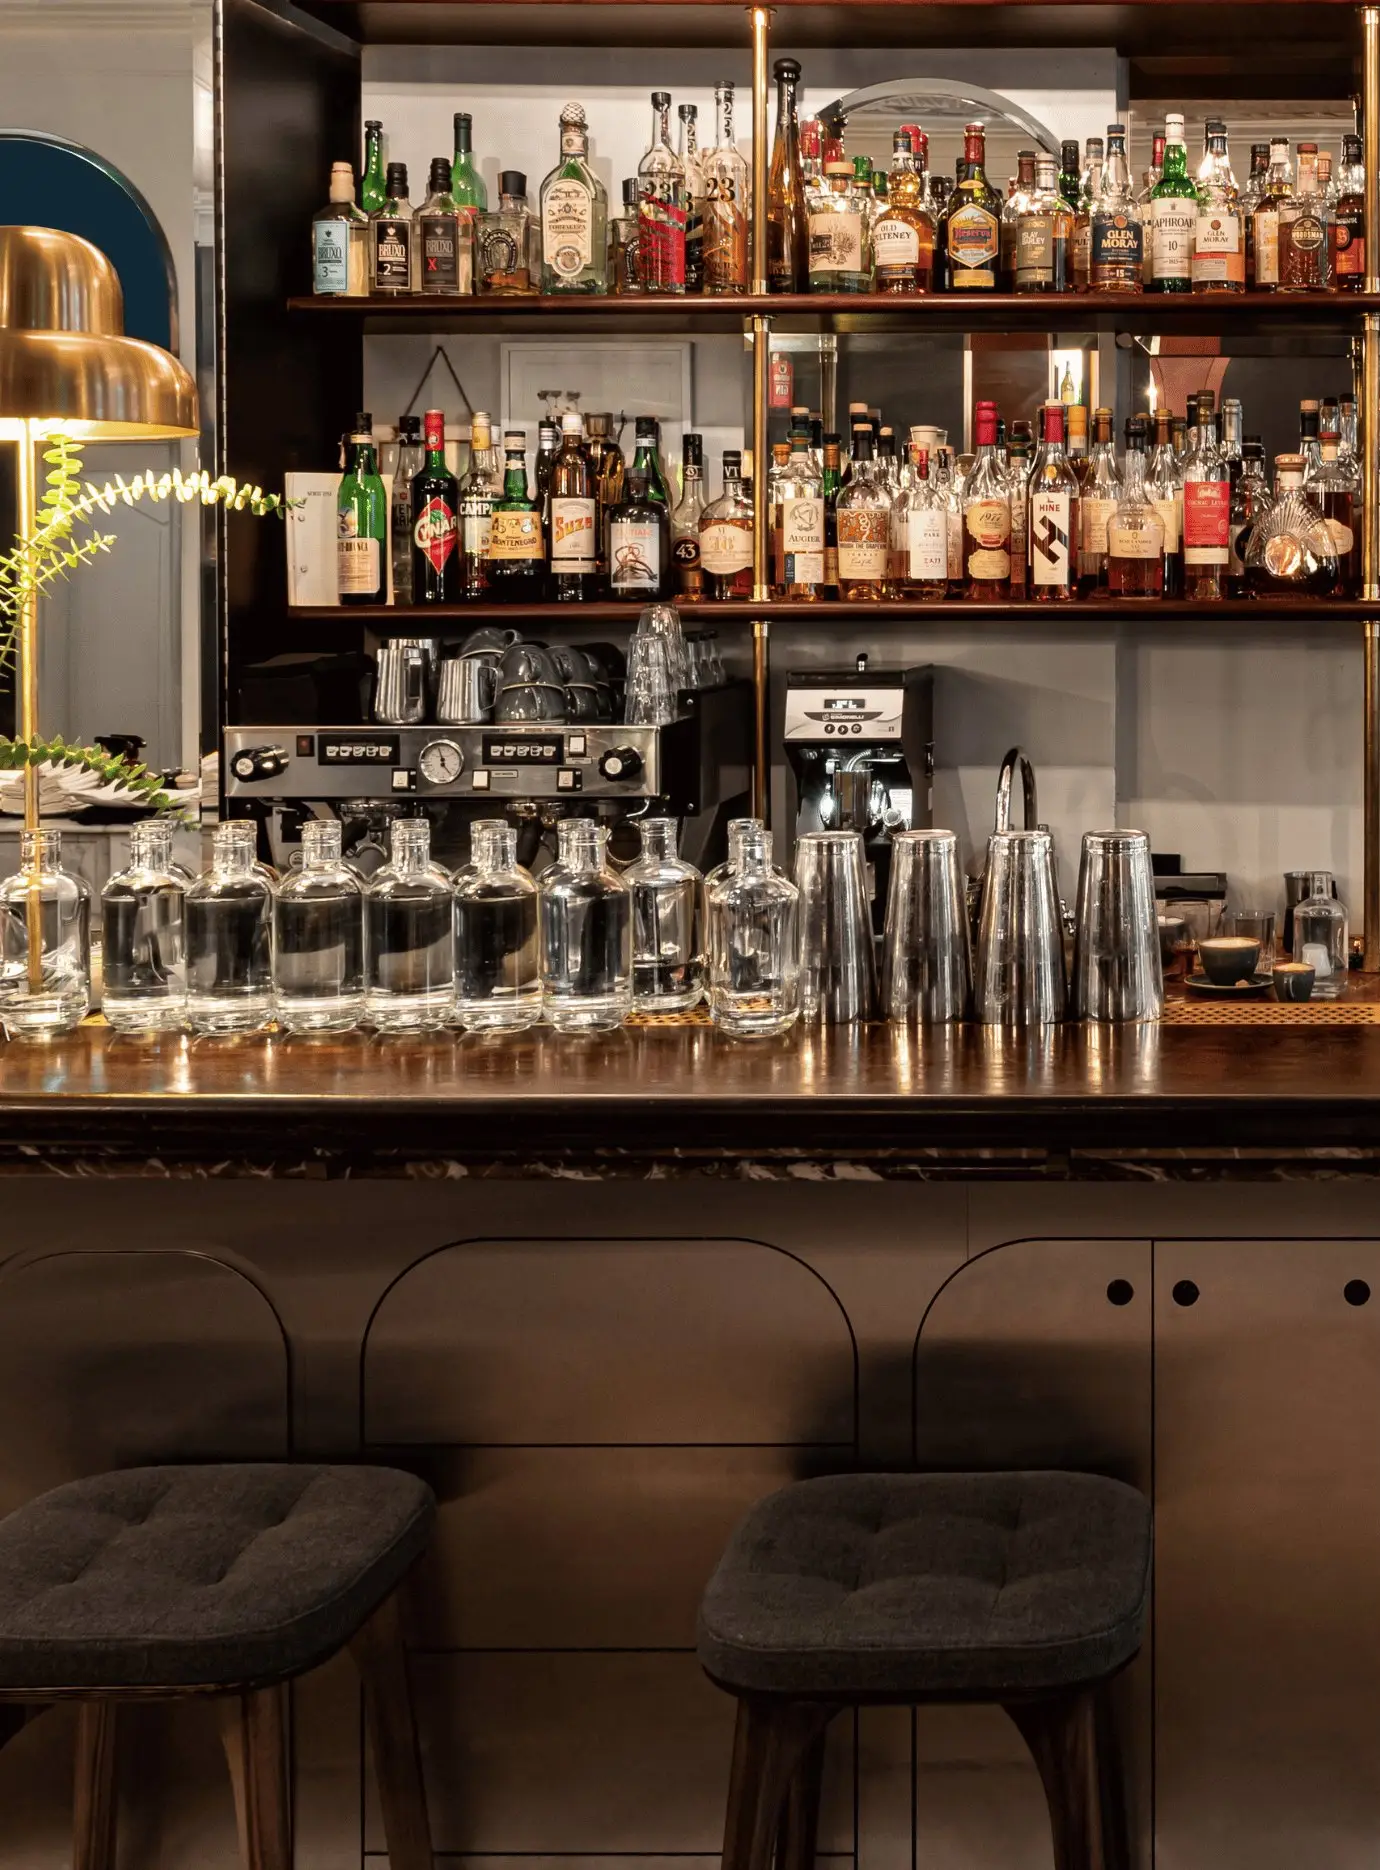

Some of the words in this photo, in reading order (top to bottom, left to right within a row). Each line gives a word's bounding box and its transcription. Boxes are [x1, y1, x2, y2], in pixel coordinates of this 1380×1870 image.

[706, 177, 736, 202] 23
[1153, 217, 1193, 228] APHROAI
[875, 231, 912, 241] LTENEY
[1107, 230, 1134, 240] GLEN
[1292, 231, 1324, 240] WOODSMAN
[426, 240, 453, 253] BRUXO
[1101, 239, 1138, 249] MORAY
[1168, 240, 1178, 251] 10
[318, 246, 342, 259] BRUXO
[379, 244, 406, 257] BRUXO
[383, 263, 392, 276] 2
[427, 257, 437, 271] X
[322, 266, 329, 278] 3
[724, 466, 739, 477] VT
[460, 502, 492, 515] CAMP
[1039, 504, 1060, 512] HINE
[414, 515, 457, 549] CYNAR
[554, 516, 593, 544] Suze
[788, 534, 821, 543] AUGIER
[676, 543, 696, 558] 43
